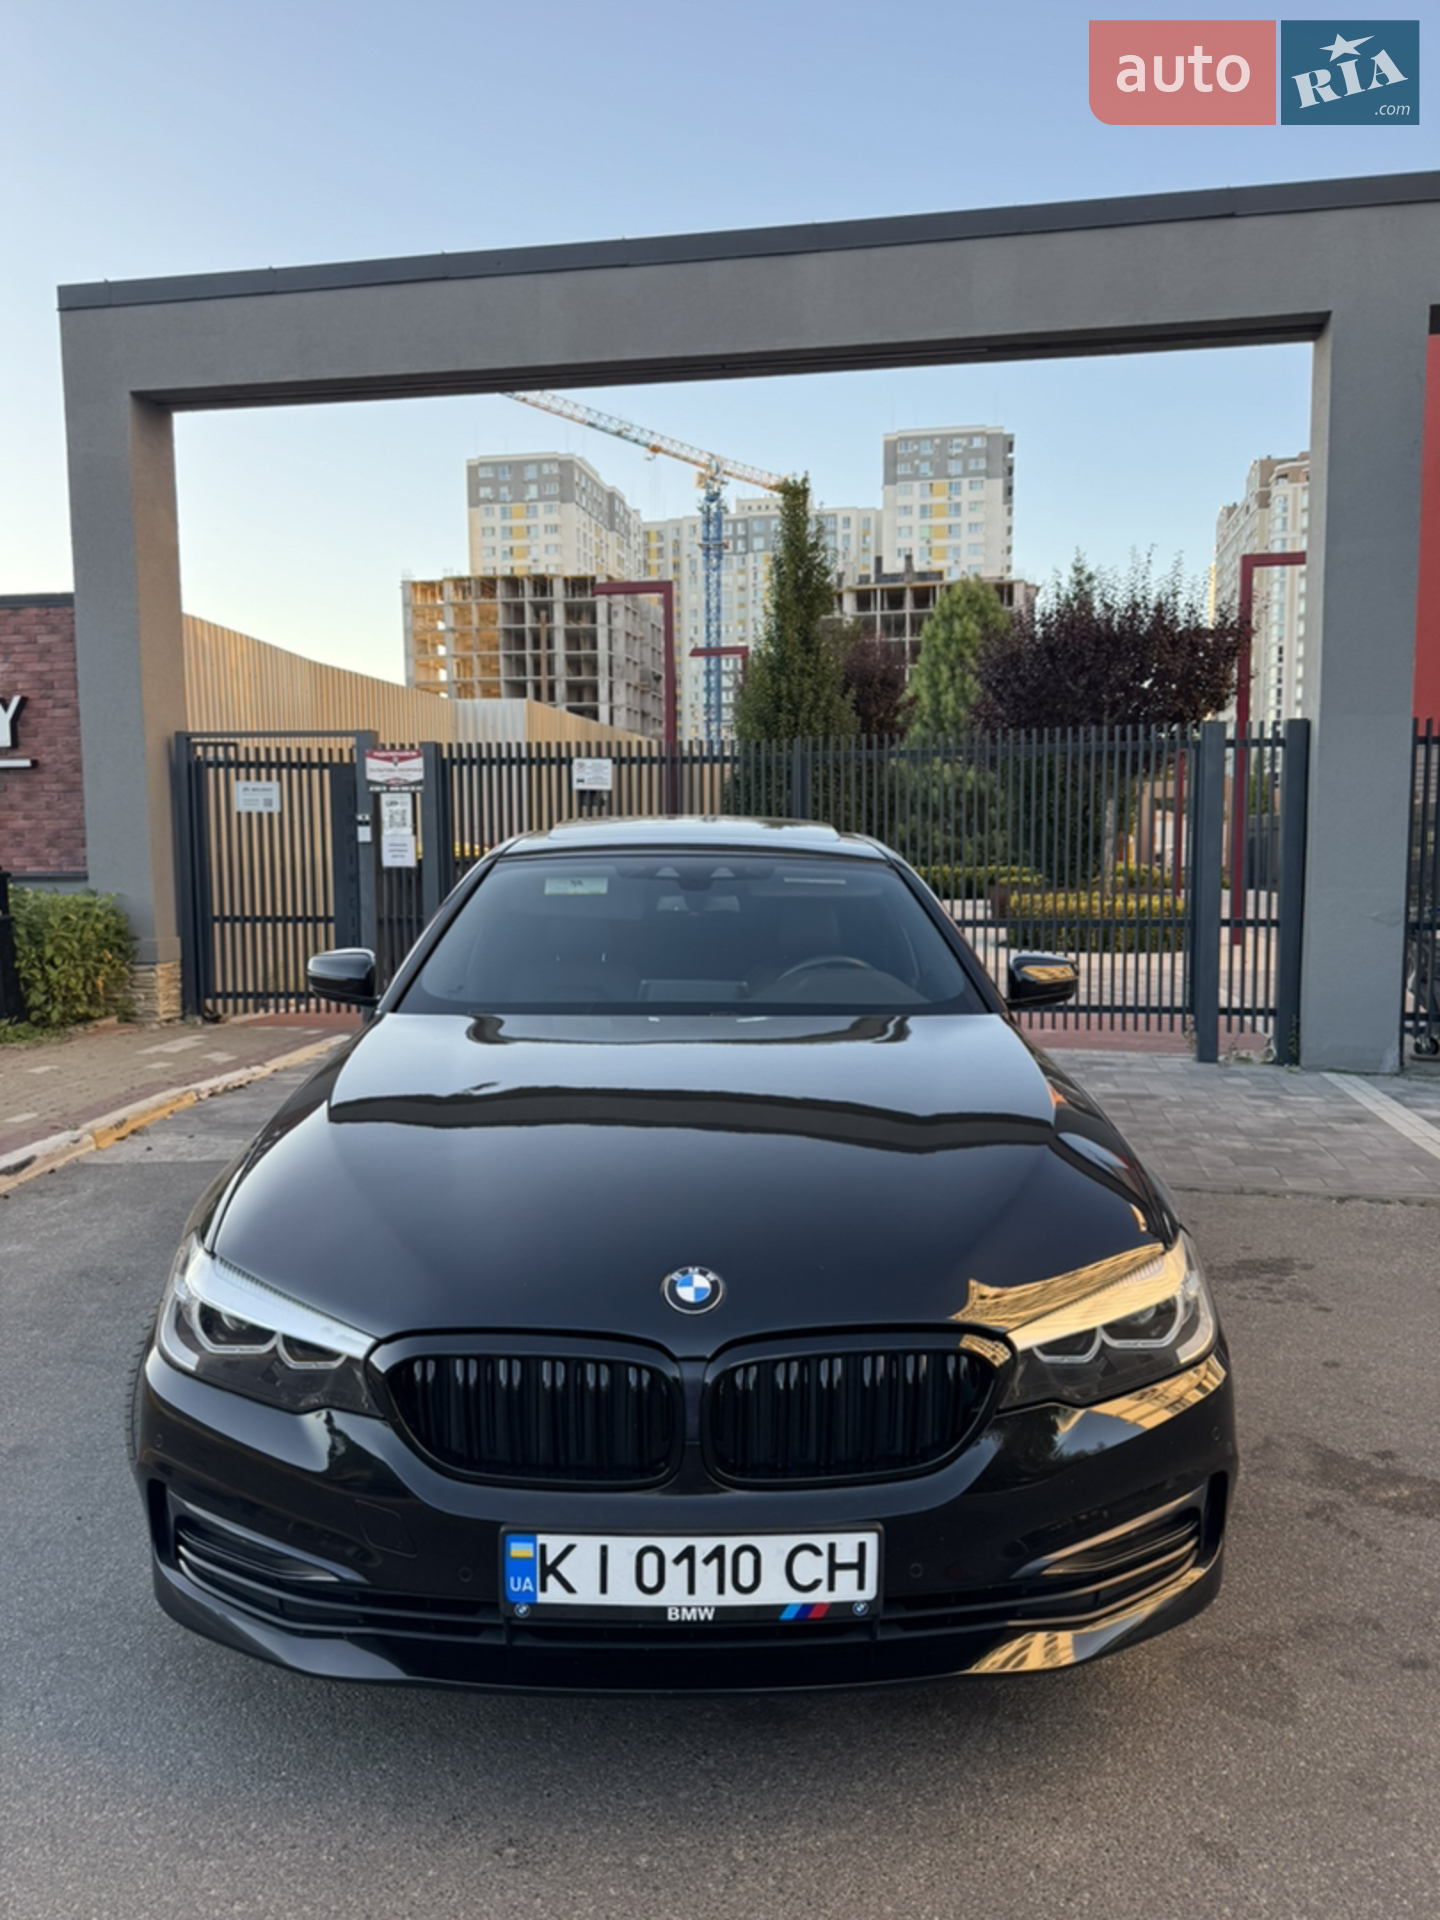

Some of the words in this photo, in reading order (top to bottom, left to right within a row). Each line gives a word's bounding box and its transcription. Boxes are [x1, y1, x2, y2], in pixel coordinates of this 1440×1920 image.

[635, 1543, 762, 1595] 0110
[785, 1541, 867, 1593] CH
[509, 1576, 534, 1592] UA
[667, 1606, 715, 1621] BMW
